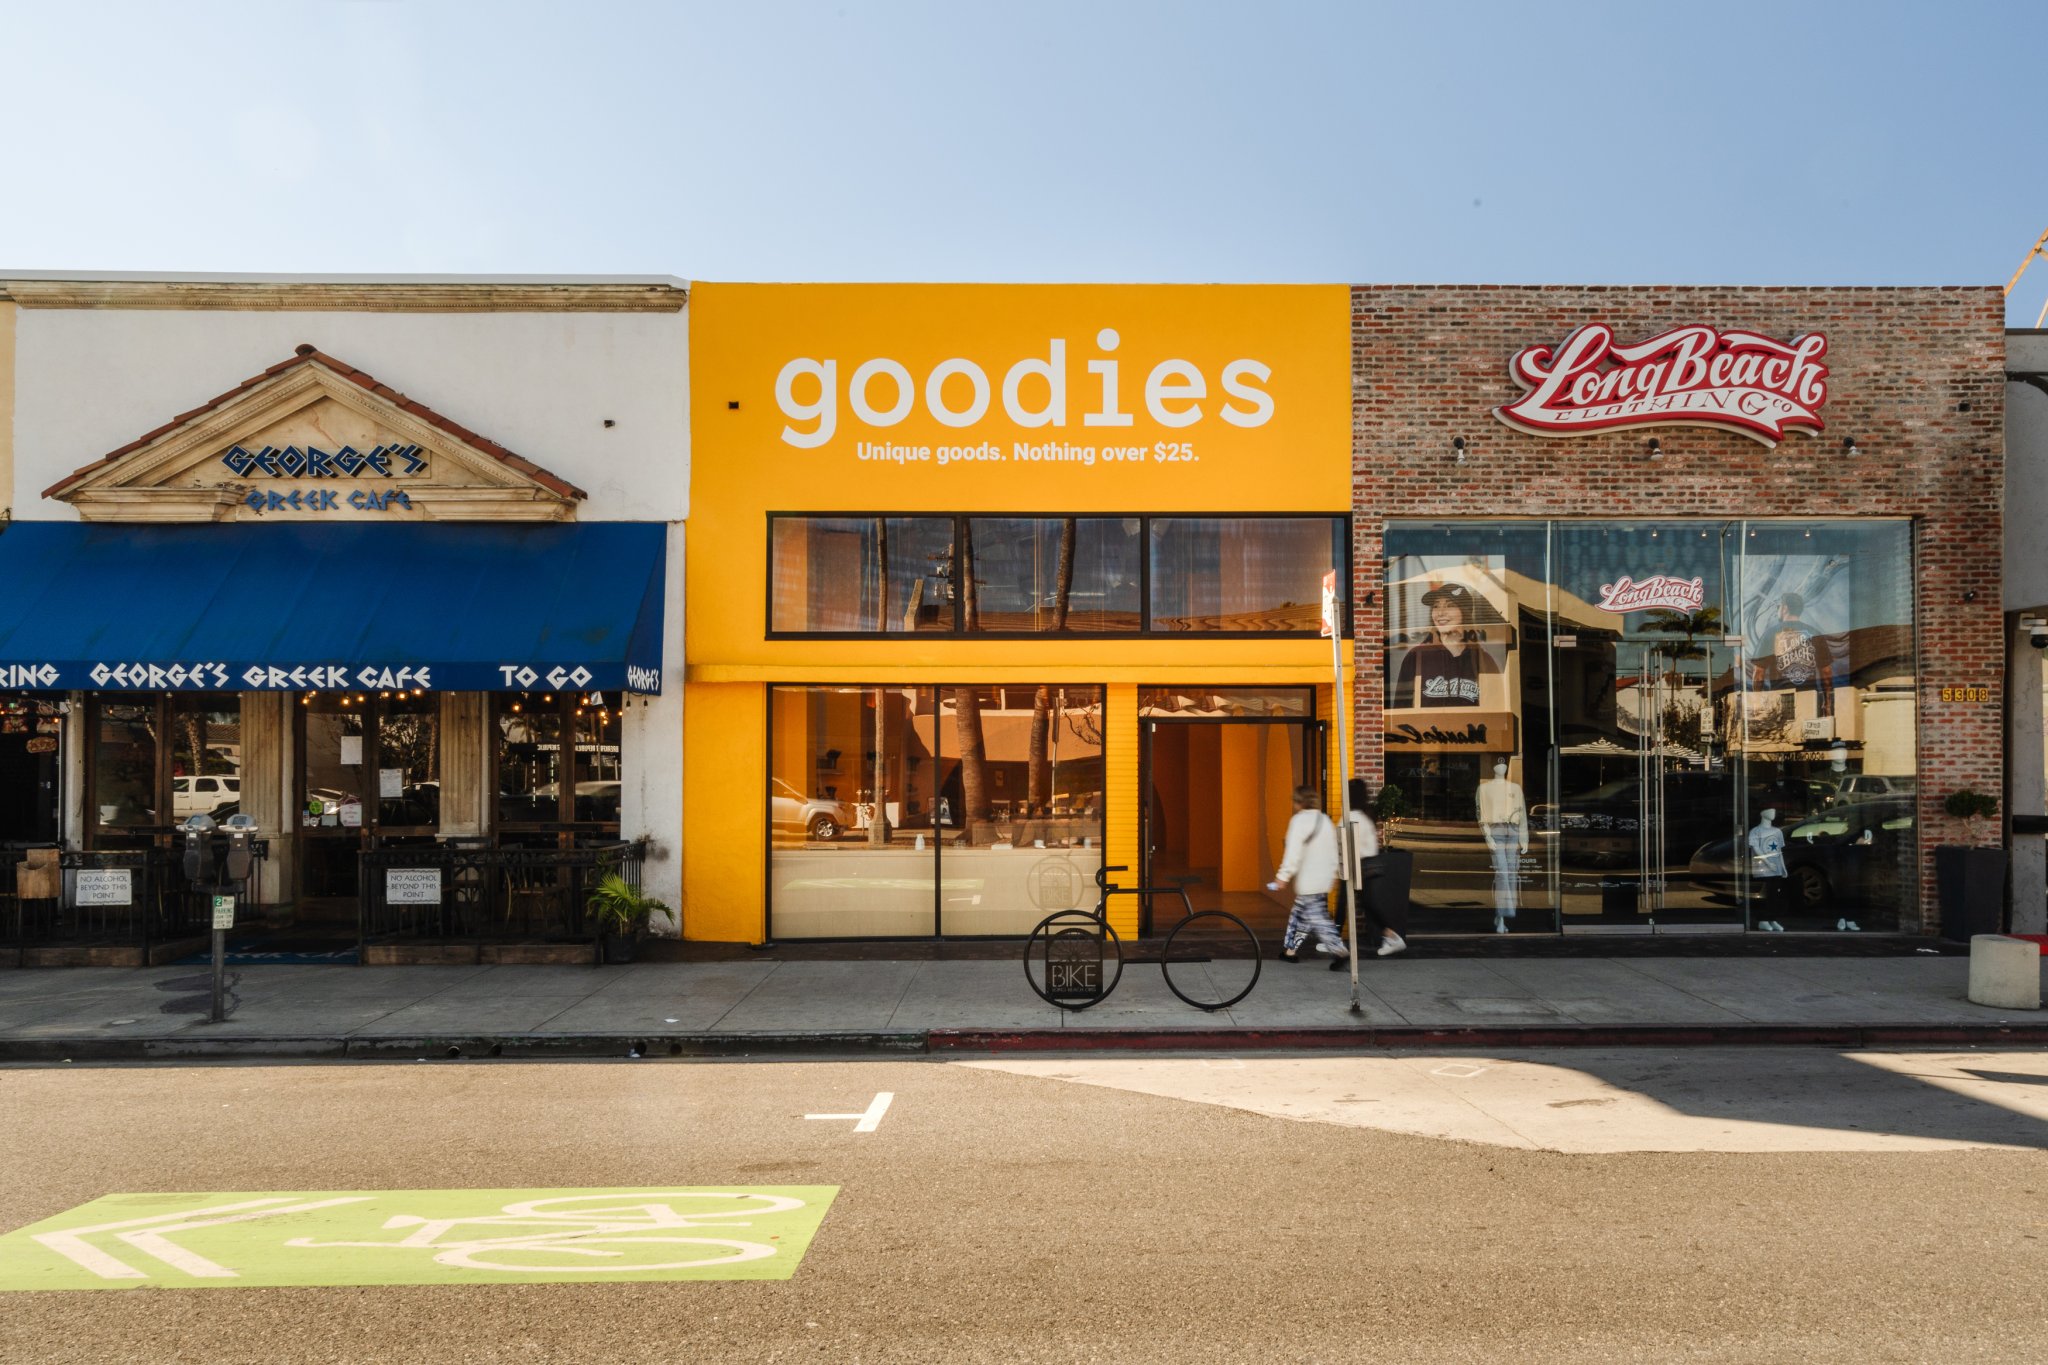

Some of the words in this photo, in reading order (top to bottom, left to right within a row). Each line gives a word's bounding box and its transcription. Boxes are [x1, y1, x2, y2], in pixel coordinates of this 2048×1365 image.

[1511, 325, 1670, 408] Long
[1613, 326, 1824, 404] Beach
[774, 327, 1275, 449] goodies
[1554, 390, 1768, 421] CLOTHING
[221, 443, 427, 477] GEORGE'S
[857, 441, 931, 465] Unique
[936, 441, 1007, 465] goods.
[1013, 442, 1096, 466] Nothing
[1101, 447, 1148, 462] over
[1153, 441, 1200, 463] $25.
[245, 489, 339, 511] GREEK
[346, 489, 412, 511] CAFE
[89, 662, 230, 689] GEORGE'S
[242, 665, 350, 688] GREEK
[356, 665, 432, 689] CAFE
[499, 665, 539, 688] TO
[545, 665, 593, 690] GO
[627, 664, 660, 692] GEORGE'S
[1943, 688, 1987, 701] 5308
[1052, 965, 1096, 987] BIKE
